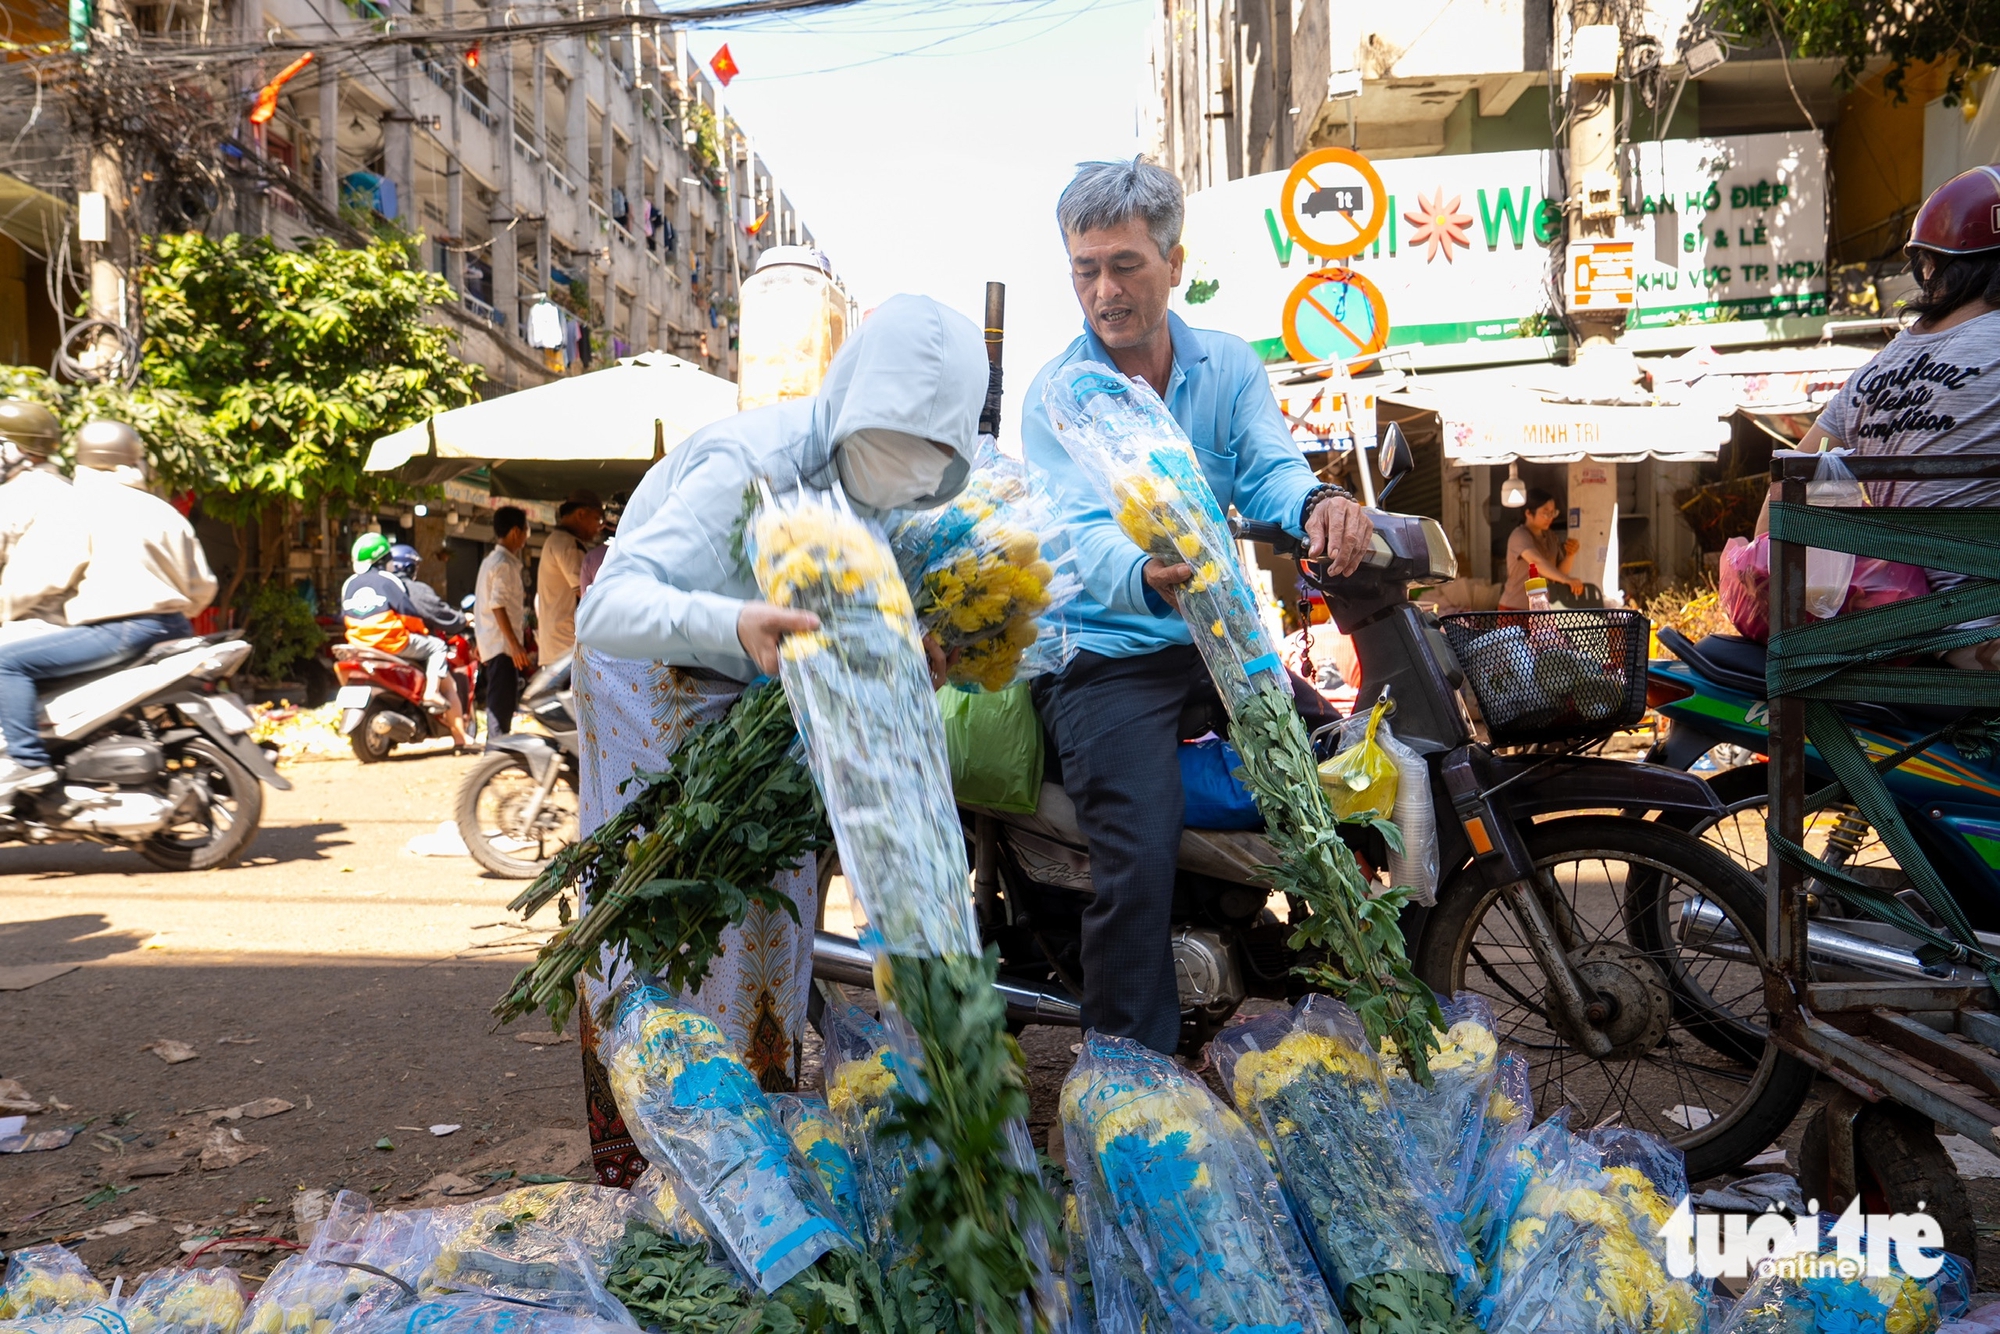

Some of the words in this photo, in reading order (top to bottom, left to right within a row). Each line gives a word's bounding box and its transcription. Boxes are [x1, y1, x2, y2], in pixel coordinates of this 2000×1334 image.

[1335, 191, 1353, 209] 1t
[1624, 193, 1675, 216] LAN
[1731, 179, 1789, 211] ĐIỆP
[1713, 228, 1729, 248] &
[1636, 272, 1678, 292] KHU
[1741, 265, 1769, 282] TP.
[1777, 261, 1824, 280] HCM
[1524, 424, 1568, 444] MINH
